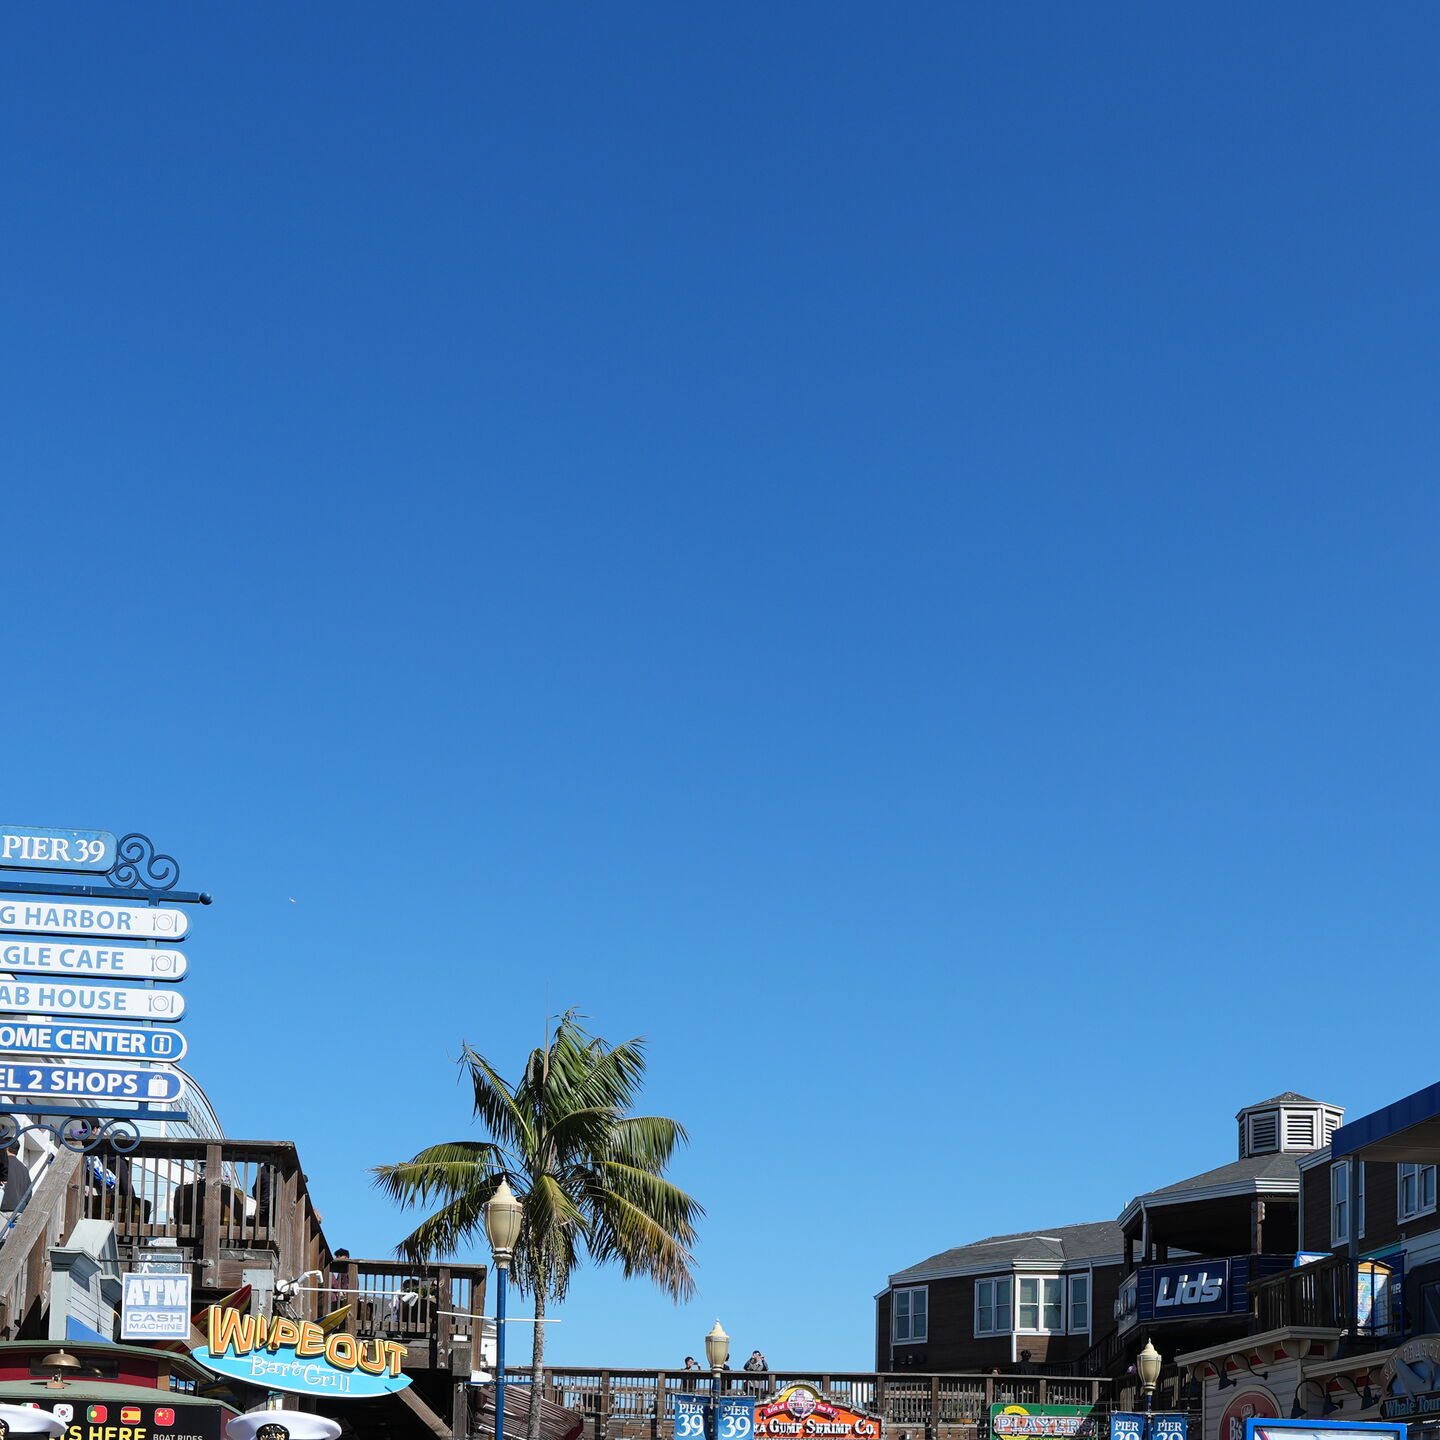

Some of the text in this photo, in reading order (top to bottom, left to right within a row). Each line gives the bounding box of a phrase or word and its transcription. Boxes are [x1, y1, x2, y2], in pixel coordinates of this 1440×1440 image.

[2, 835, 106, 863] PIER 39
[24, 907, 131, 930] HARBOR
[60, 949, 124, 970] CAFE
[38, 987, 127, 1011] HOUSE
[55, 1029, 146, 1053] CENTER
[27, 1070, 43, 1090] 2
[50, 1071, 138, 1094] SHOPS
[126, 1280, 187, 1306] ATM
[1155, 1271, 1223, 1308] Lids
[130, 1313, 183, 1322] CASH
[208, 1304, 409, 1377] WIPEOUT
[679, 1403, 704, 1414] PIER
[1385, 1397, 1416, 1417] Whale
[677, 1414, 705, 1437] 39
[721, 1416, 752, 1438] 39
[769, 1418, 803, 1434] GUMP
[805, 1419, 851, 1435] SHRIMP
[1114, 1421, 1139, 1432] PIER
[1157, 1422, 1182, 1432] PIER
